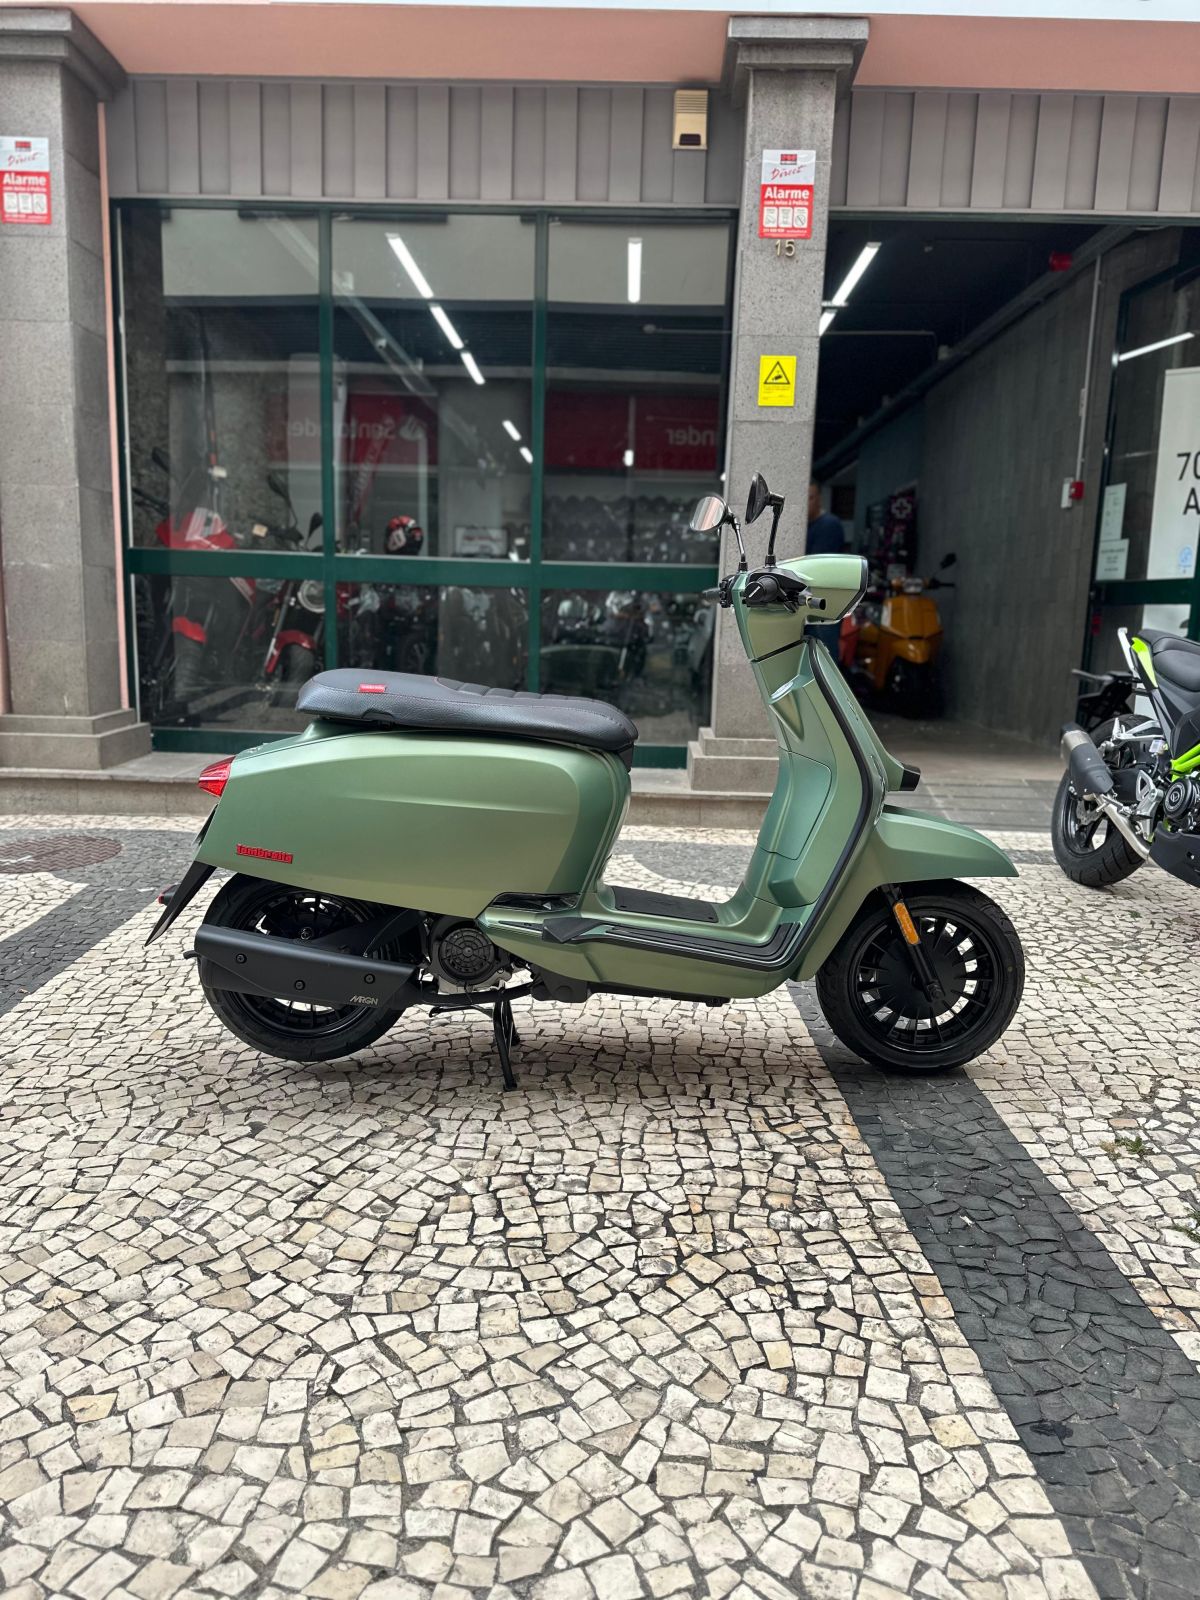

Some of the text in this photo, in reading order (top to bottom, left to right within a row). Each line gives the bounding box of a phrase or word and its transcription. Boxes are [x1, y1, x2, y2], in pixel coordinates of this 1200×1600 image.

[3, 172, 46, 186] Alarme
[765, 187, 810, 199] Alarme
[775, 239, 796, 257] 15
[236, 843, 293, 864] Lambretta
[350, 995, 379, 1006] MRGN
